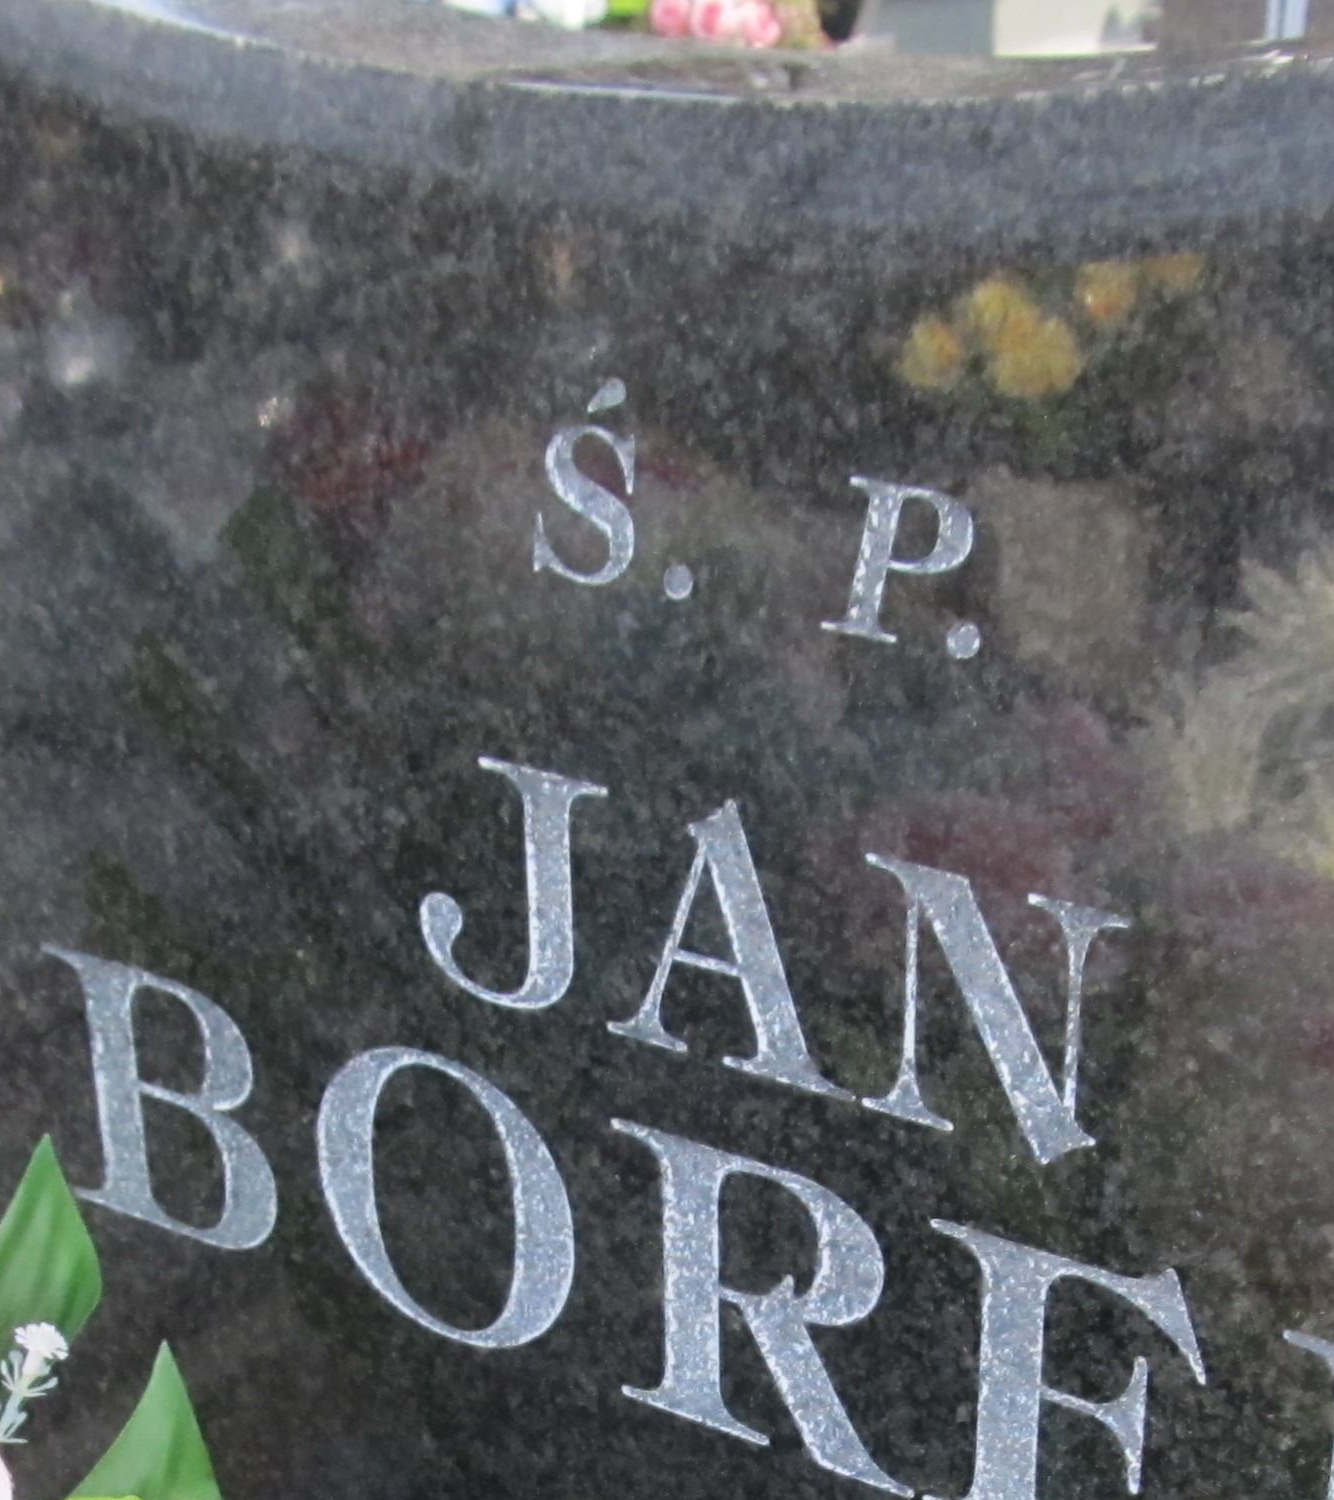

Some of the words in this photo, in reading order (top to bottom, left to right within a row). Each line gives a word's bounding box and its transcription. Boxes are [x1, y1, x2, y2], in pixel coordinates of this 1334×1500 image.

[533, 378, 695, 602] Ś.
[820, 473, 982, 661] P.
[417, 754, 1131, 1167] JAN
